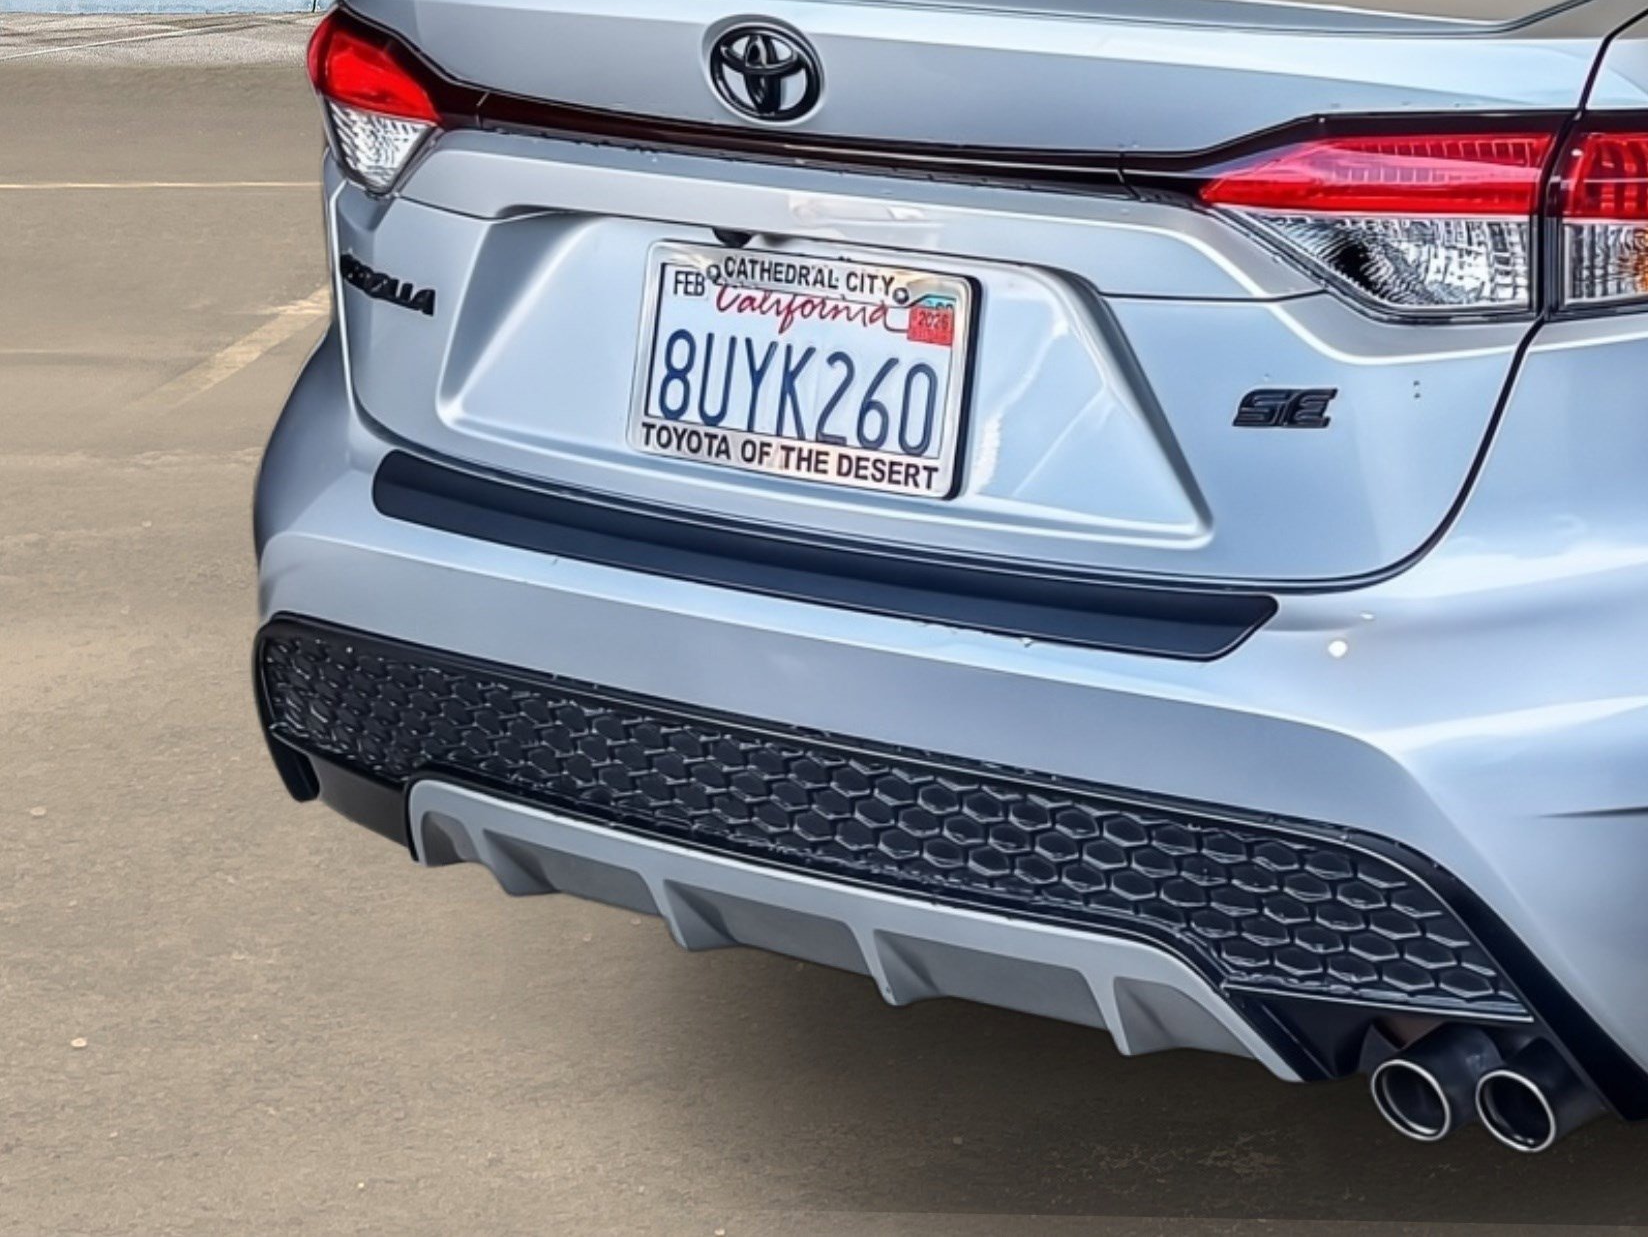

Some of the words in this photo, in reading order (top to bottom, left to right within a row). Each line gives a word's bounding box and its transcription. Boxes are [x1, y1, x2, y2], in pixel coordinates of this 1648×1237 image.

[673, 270, 706, 296] FEB
[724, 256, 839, 290] CATHEDRAL
[846, 271, 895, 296] CITY
[716, 284, 889, 335] California
[658, 329, 938, 457] 8UYK260
[1232, 388, 1338, 428] SE
[641, 422, 731, 459] TOYOTA
[741, 439, 772, 465] OF
[780, 445, 829, 474] THE
[836, 453, 939, 490] DESERT
